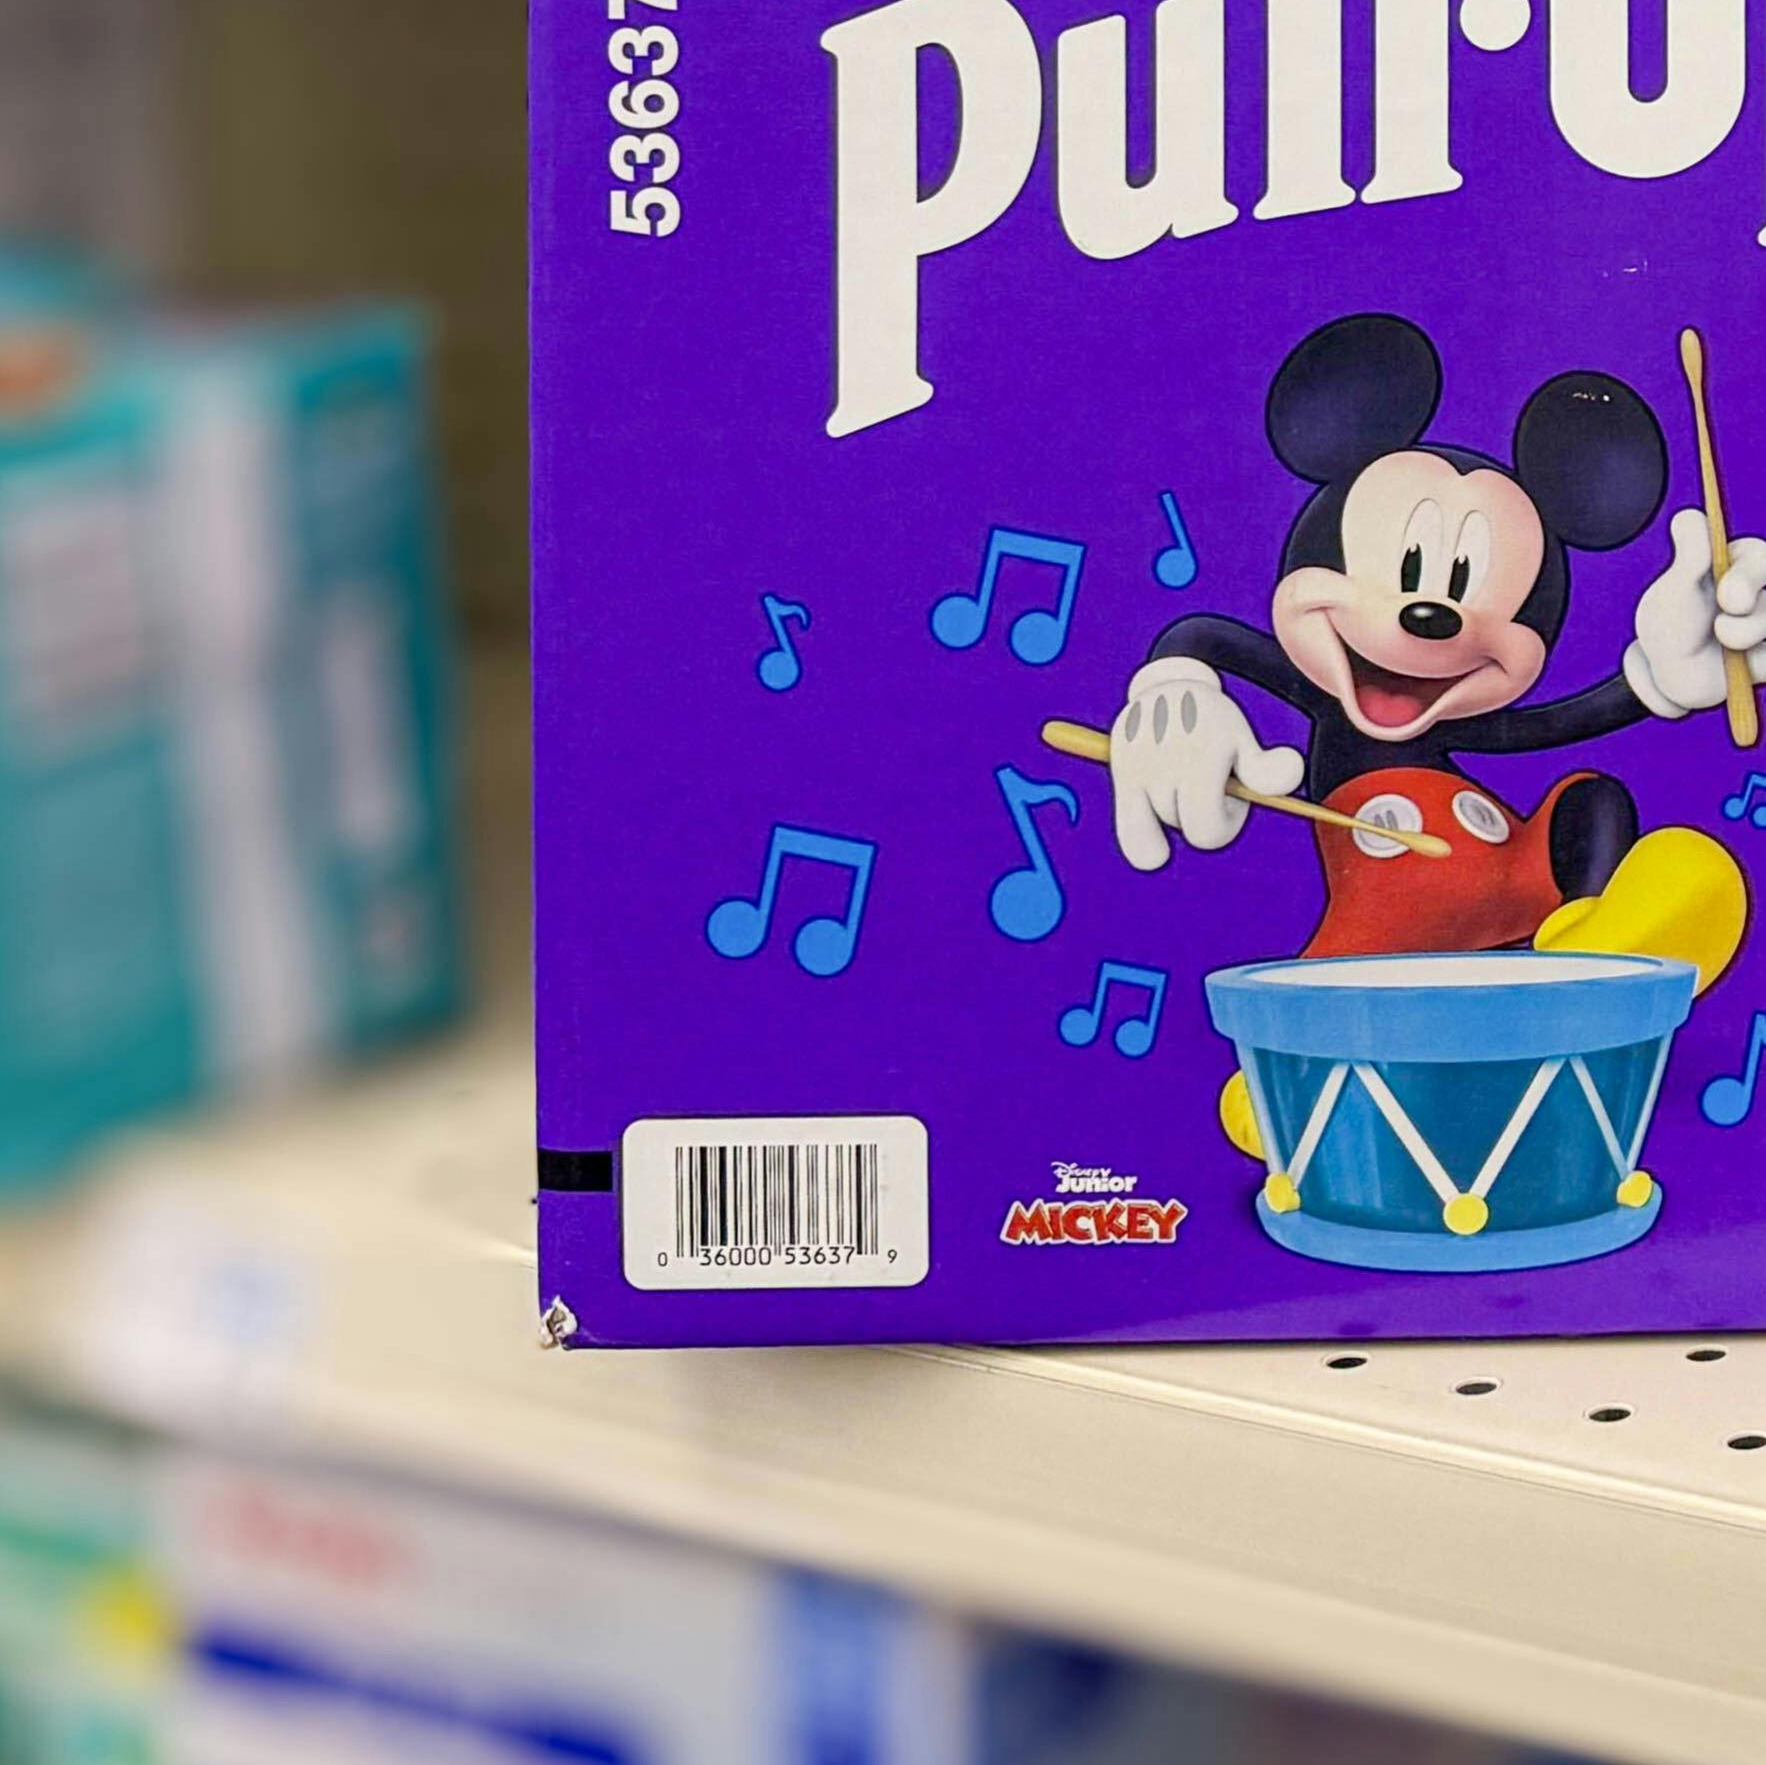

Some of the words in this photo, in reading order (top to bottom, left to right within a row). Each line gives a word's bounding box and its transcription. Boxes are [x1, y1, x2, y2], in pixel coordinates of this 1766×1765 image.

[1055, 1175, 1137, 1193] Junior
[1000, 1198, 1188, 1245] MICKEY
[658, 1252, 667, 1267] 0
[699, 1246, 772, 1266] 36000
[784, 1246, 855, 1265] 53637
[888, 1249, 897, 1263] 9
